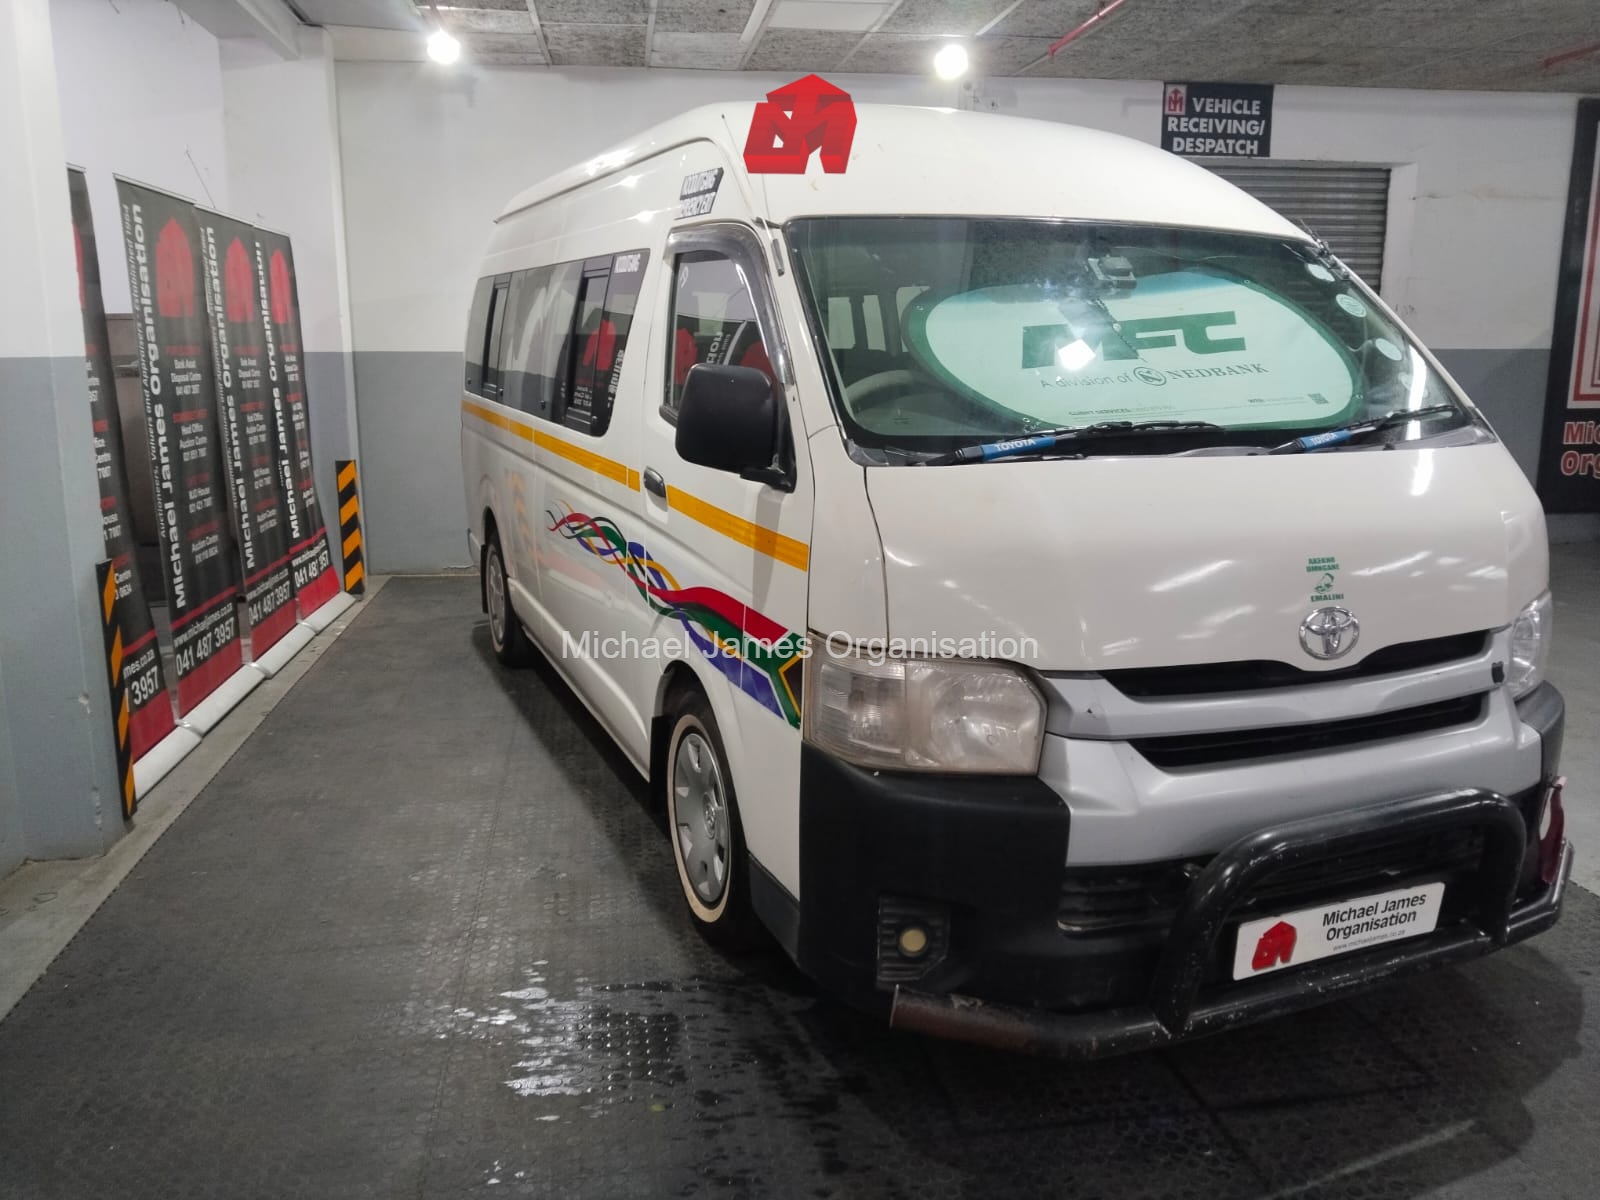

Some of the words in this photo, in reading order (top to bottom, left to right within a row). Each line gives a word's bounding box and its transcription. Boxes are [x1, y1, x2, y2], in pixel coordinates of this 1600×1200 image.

[1167, 117, 1265, 135] RECEIVING/
[1192, 97, 1261, 115] VEHICLE
[1172, 137, 1259, 155] DESPATCH
[132, 204, 161, 396] Organisation
[206, 227, 232, 388] Organisation
[1055, 374, 1114, 388] division
[1118, 372, 1133, 384] of
[1165, 363, 1270, 380] NEDBANK
[227, 395, 242, 471] James
[272, 387, 288, 454] James
[1310, 432, 1338, 446] TOYOTA
[154, 403, 173, 494] James
[994, 438, 1037, 452] TOYOTA
[281, 459, 300, 539] Michael
[236, 478, 255, 569] Michael
[164, 501, 186, 609] Michael
[294, 566, 308, 588] 041
[175, 645, 195, 677] 041
[196, 632, 213, 660] 487
[213, 616, 235, 648] 3957
[131, 665, 160, 705] 3957
[1321, 902, 1380, 927] Michael
[1381, 893, 1427, 914] James
[1326, 910, 1417, 942] Organisation
